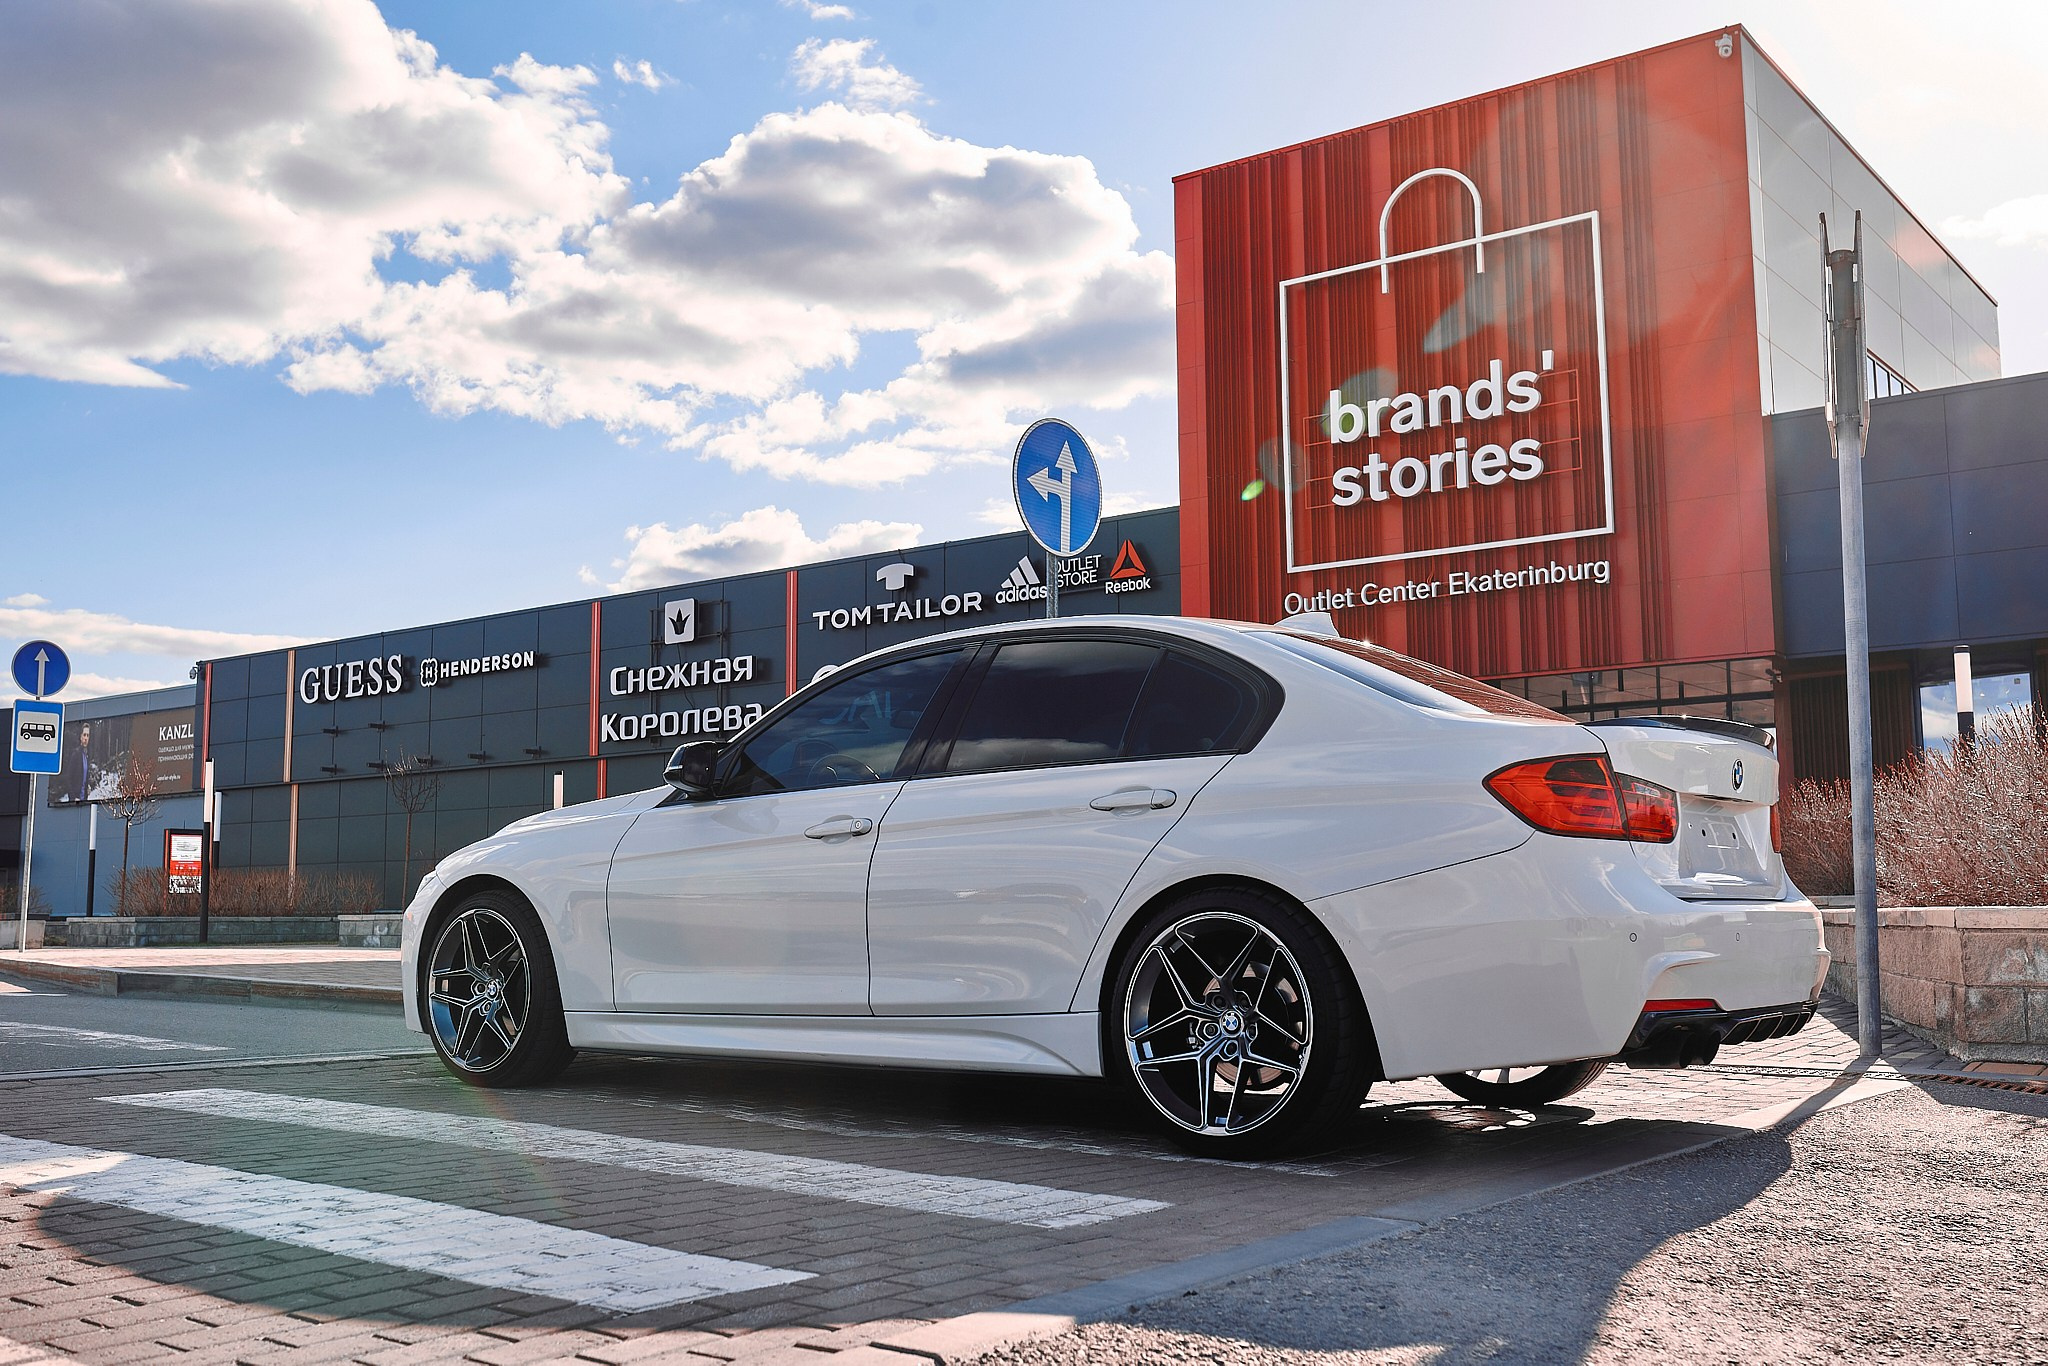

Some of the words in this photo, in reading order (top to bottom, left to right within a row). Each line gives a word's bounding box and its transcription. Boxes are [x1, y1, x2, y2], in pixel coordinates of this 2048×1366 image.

[1329, 350, 1554, 444] brands'
[1331, 437, 1545, 507] stories
[995, 584, 1048, 604] adidas
[1105, 577, 1151, 595] Reebok
[1284, 587, 1355, 615] Outlet
[1360, 577, 1440, 606] Center
[1449, 560, 1609, 595] Ekaterinburg
[812, 605, 872, 631] TOM
[876, 591, 983, 623] TAILOR
[300, 654, 402, 704] GUESS
[440, 650, 534, 679] HENDERSON
[610, 655, 754, 696] Снежная
[159, 723, 194, 741] KANZL
[601, 703, 764, 743] Королева
